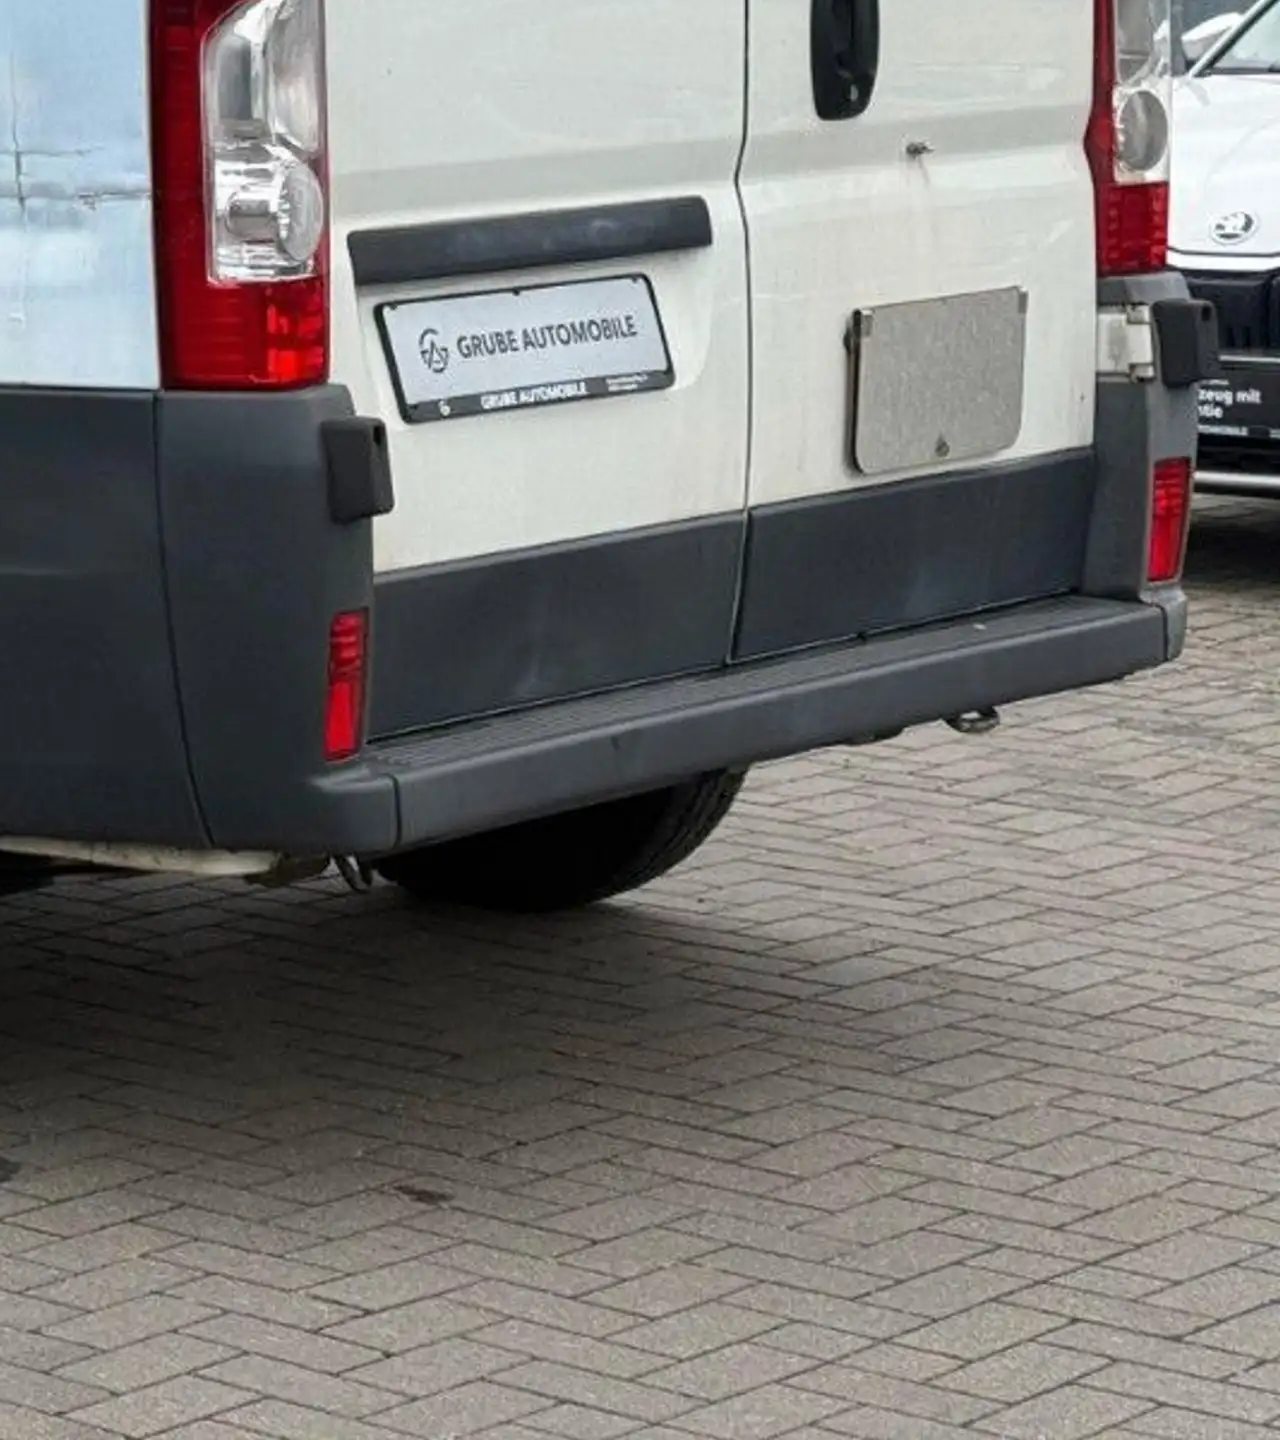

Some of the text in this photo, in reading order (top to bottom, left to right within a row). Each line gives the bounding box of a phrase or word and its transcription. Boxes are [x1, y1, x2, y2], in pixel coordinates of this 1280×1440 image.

[456, 314, 638, 359] GRUBE AUTOMOBILE
[480, 391, 519, 410] GRUBE
[519, 381, 589, 403] AUTOMOBILE
